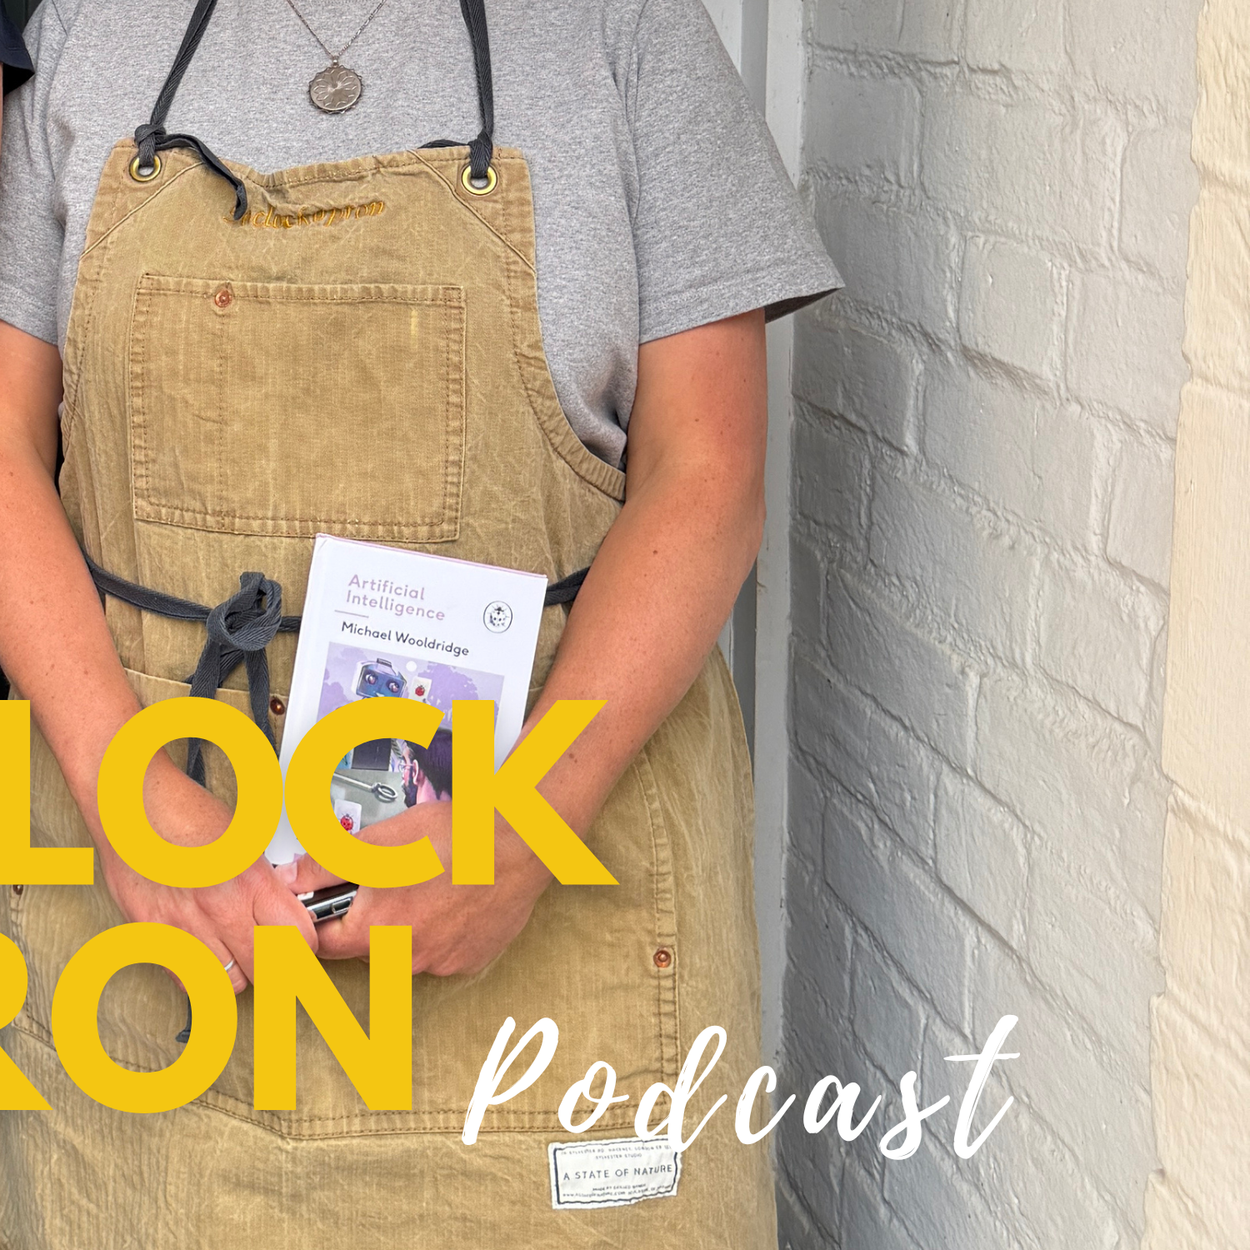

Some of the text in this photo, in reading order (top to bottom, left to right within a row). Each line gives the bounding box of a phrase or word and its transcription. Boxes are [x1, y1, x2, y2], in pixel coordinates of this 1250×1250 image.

[348, 574, 425, 601] Artificial
[346, 589, 446, 621] Intelligence
[341, 621, 470, 657] Michael Wooldridge
[563, 1164, 673, 1181] A STATE OF NATURE
